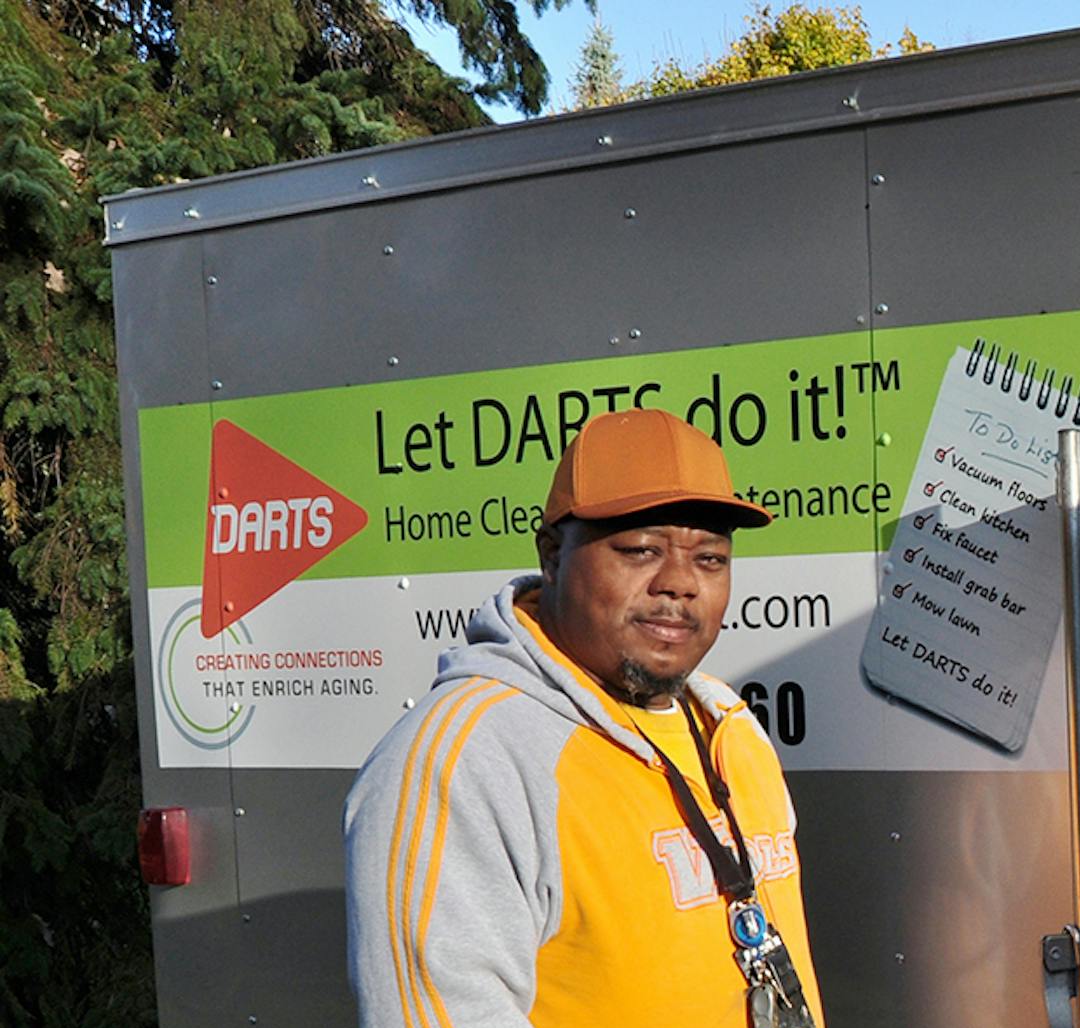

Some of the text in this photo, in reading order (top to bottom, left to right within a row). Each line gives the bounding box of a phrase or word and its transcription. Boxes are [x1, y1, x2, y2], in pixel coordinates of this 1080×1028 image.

[376, 409, 456, 475] Let
[686, 373, 767, 447] do
[965, 409, 1060, 465] To Do Lis
[951, 452, 1048, 511] Vacuum floors
[211, 496, 333, 554] DARTS
[385, 506, 471, 542] Home
[733, 482, 891, 519] tenance
[939, 489, 1030, 543] Clean kitchen
[932, 521, 999, 561] Fix faucet
[911, 591, 980, 637] Mow lawn
[921, 555, 1027, 616] Install grab bar
[196, 649, 383, 671] CREATING CONNECTIONS
[203, 678, 379, 697] THAT ENRICH AGING.
[881, 626, 1018, 708] Let DARTS do it!
